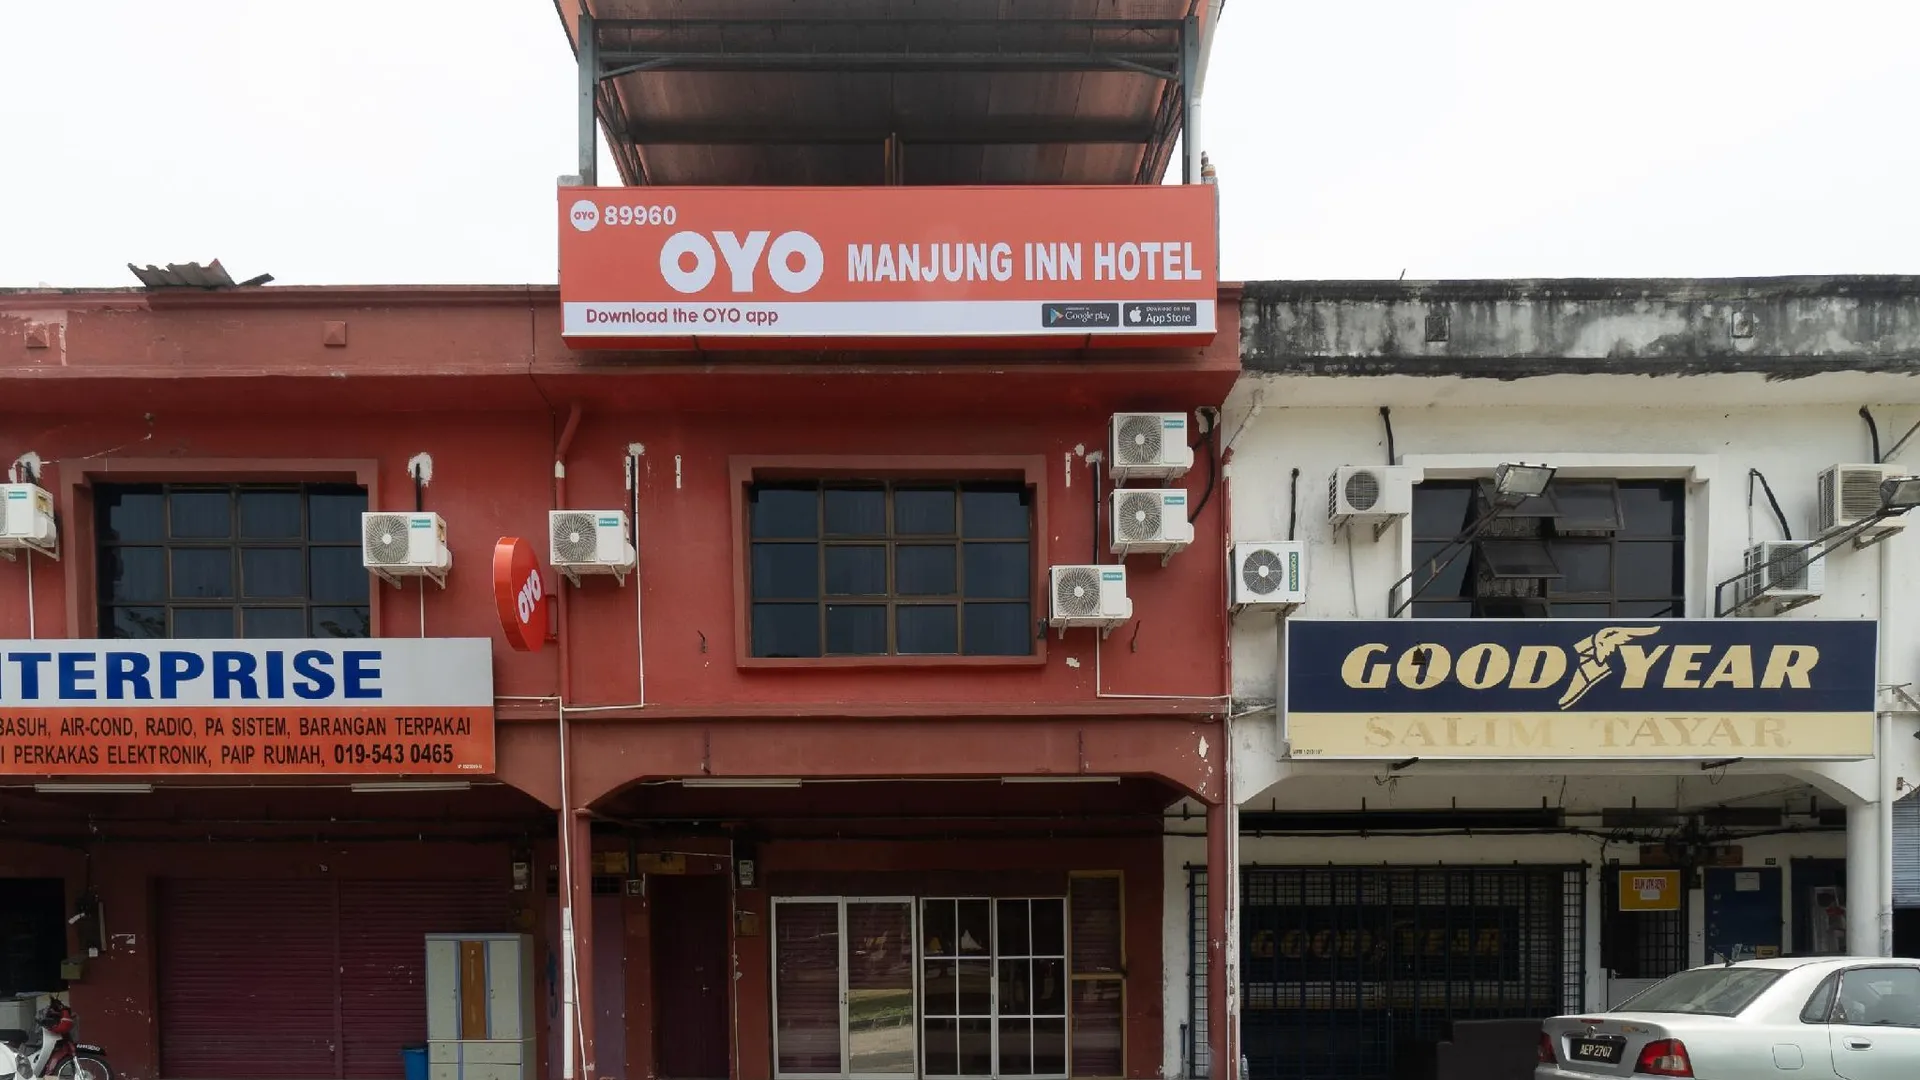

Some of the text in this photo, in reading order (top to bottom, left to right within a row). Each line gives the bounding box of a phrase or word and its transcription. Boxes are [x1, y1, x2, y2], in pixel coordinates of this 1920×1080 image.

[574, 211, 595, 220] OYO
[604, 206, 676, 225] 89960
[660, 231, 824, 293] OYO
[847, 241, 1202, 282] MANJUNG INN HOTEL
[586, 308, 778, 326] Download the OYO app
[1065, 311, 1110, 322] Google play
[1146, 313, 1191, 324] App Store
[518, 569, 541, 624] OYO
[0, 650, 382, 699] TERPRISE
[1341, 643, 1820, 690] GOOD YEAR
[60, 717, 138, 738] AIR-COND,
[145, 717, 197, 738] RADIO,
[205, 717, 224, 736] PA
[232, 717, 291, 739] SISTEM,
[299, 717, 387, 736] BARANGAN
[395, 717, 471, 736] TERPAKAI
[1364, 716, 1792, 748] SALIM TAYAR
[14, 745, 99, 764] PERKAKAS
[108, 745, 212, 767] ELEKTRONIK,
[221, 745, 255, 764] PAIP
[264, 745, 325, 767] RUMAH,
[334, 743, 404, 764] 019-543
[410, 743, 454, 764] 0465
[1580, 1044, 1613, 1058] AEP 2707
